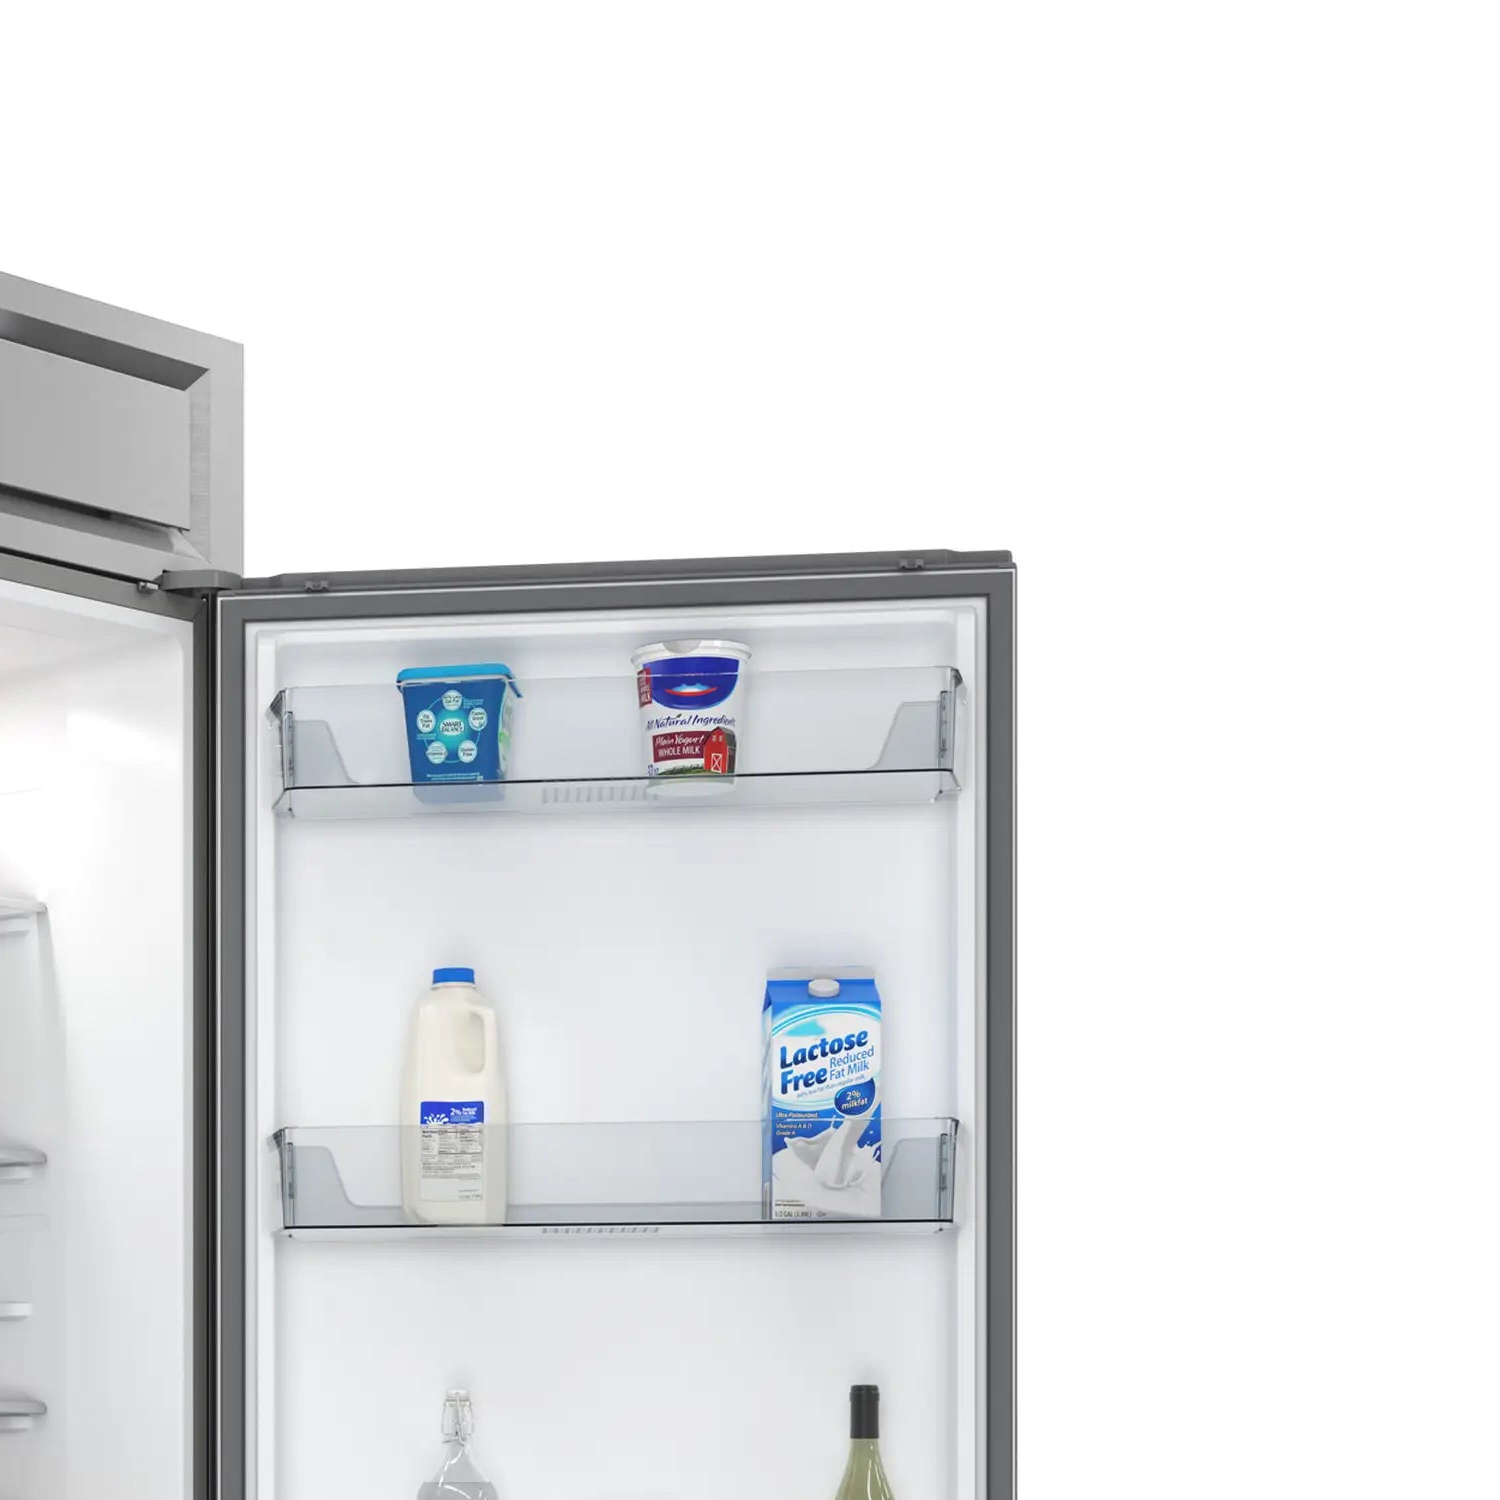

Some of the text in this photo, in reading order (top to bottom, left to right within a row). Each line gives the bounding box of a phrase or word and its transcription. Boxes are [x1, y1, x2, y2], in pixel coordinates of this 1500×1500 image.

[654, 714, 693, 729] Natural
[675, 734, 704, 745] Yogurt
[658, 745, 700, 757] WHOLE MILK
[780, 1030, 868, 1069] Lactose
[830, 1045, 875, 1069] Reduced
[830, 1060, 870, 1080] Fat Milk
[781, 1067, 828, 1095] Free
[846, 1089, 861, 1100] 2%
[841, 1097, 868, 1110] milkfat
